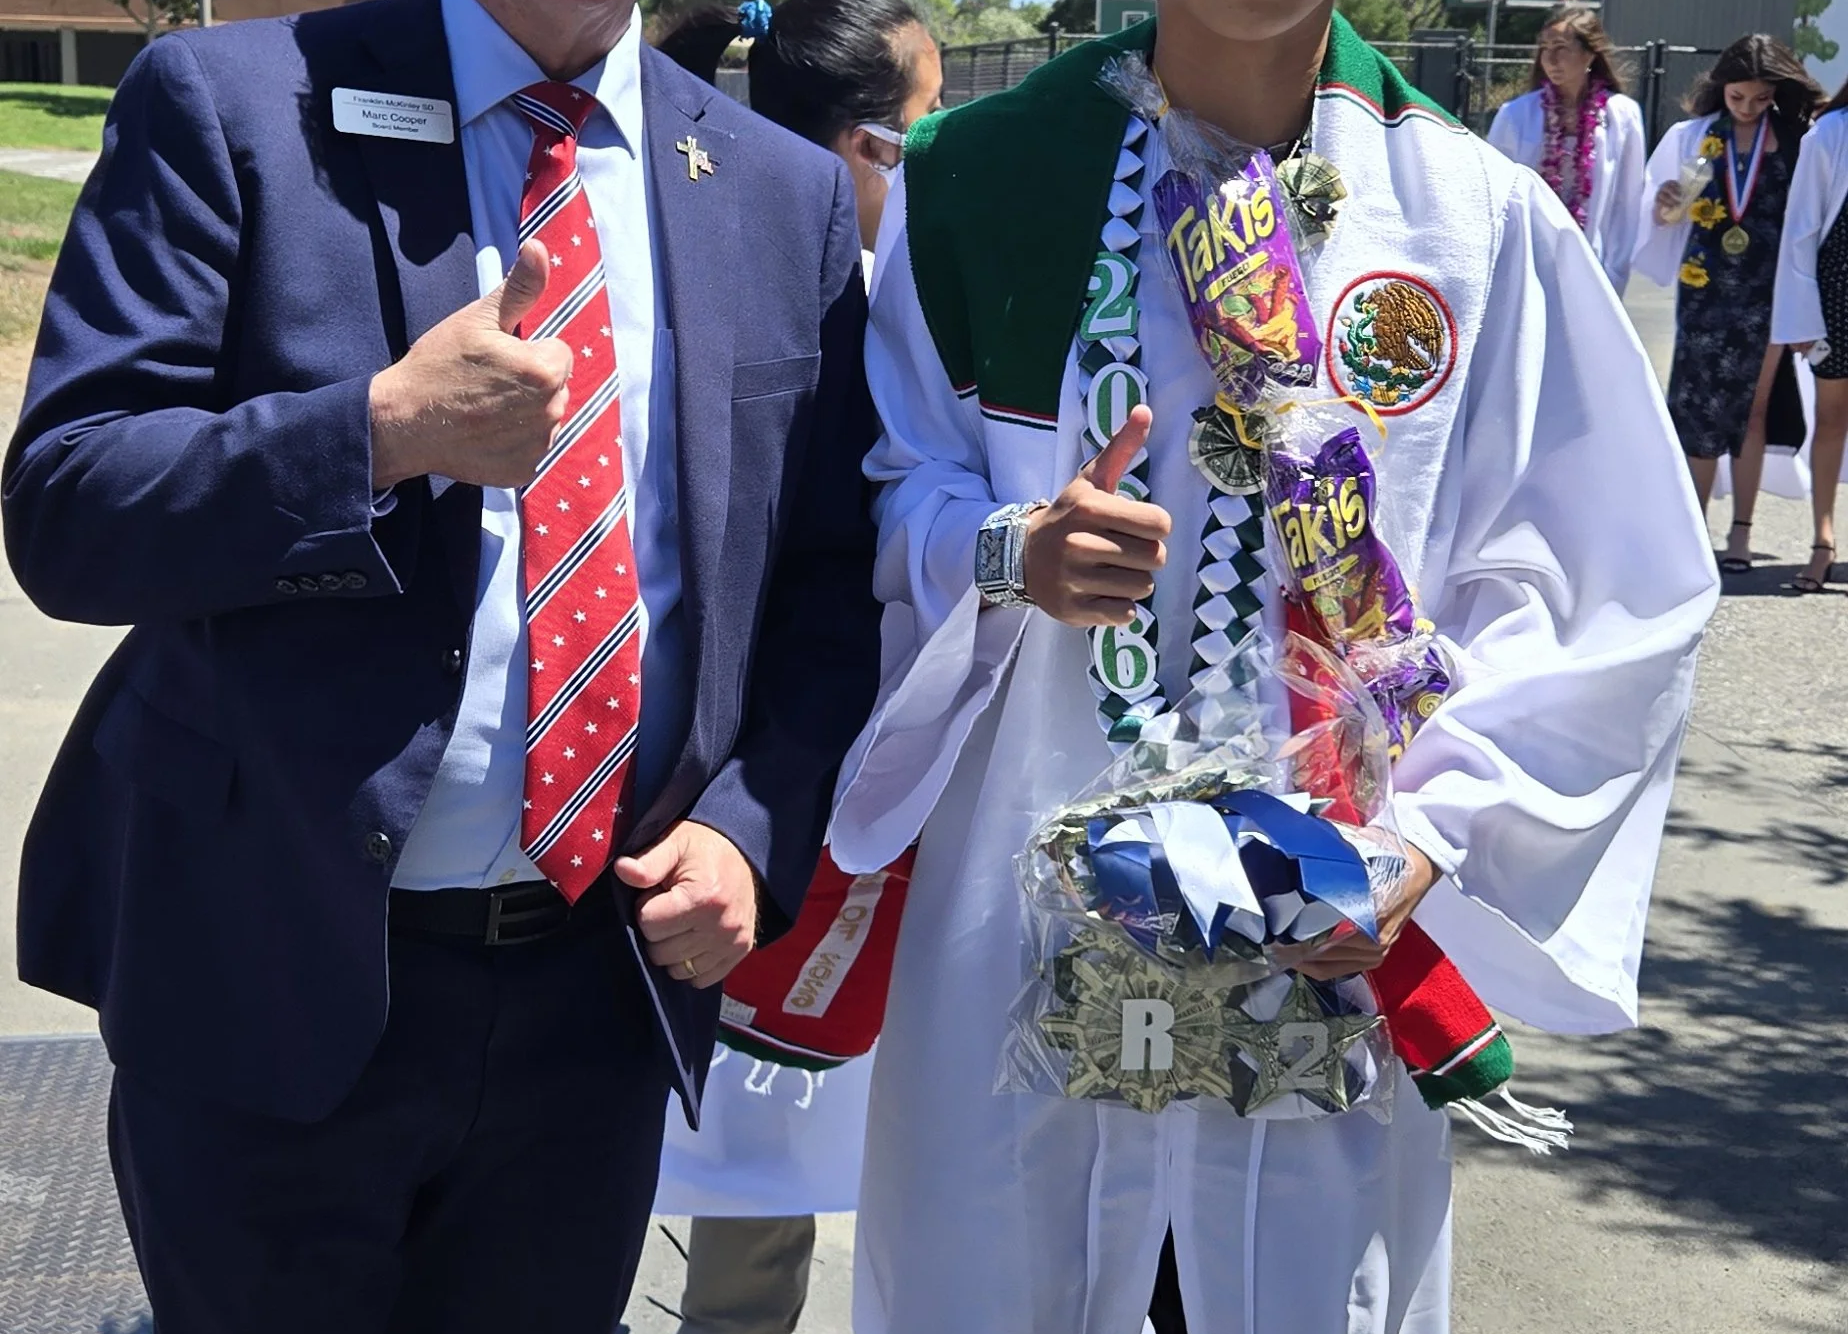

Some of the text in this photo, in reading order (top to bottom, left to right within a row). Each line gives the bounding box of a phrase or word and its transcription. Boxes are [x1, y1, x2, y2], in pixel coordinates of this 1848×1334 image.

[421, 103, 434, 111] SD
[362, 109, 427, 126] Marc Cooper
[393, 125, 419, 133] Member
[1221, 261, 1250, 287] FUEGO
[1120, 999, 1330, 1089] R 2
